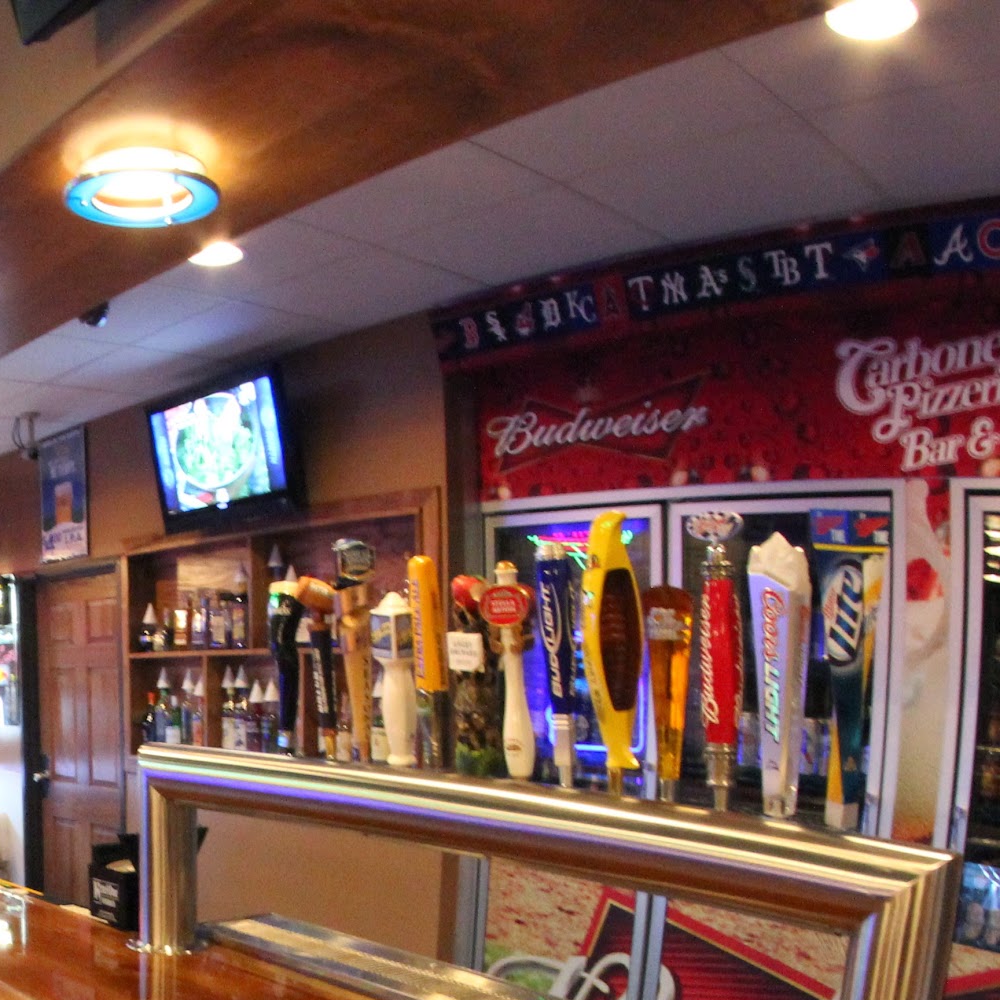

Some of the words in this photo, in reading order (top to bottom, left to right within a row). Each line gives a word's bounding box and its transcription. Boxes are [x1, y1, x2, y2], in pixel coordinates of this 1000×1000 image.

[563, 290, 597, 323] KC
[763, 249, 801, 286] TB
[804, 241, 833, 280] T
[934, 223, 975, 266] A
[486, 400, 708, 457] Budweiser
[899, 426, 966, 472] Bar
[966, 415, 1000, 460] &
[538, 580, 558, 648] LIGHT
[761, 586, 785, 667] Coors
[550, 648, 564, 699] BUD
[700, 579, 720, 727] Budweiser
[764, 660, 782, 744] LIGHT
